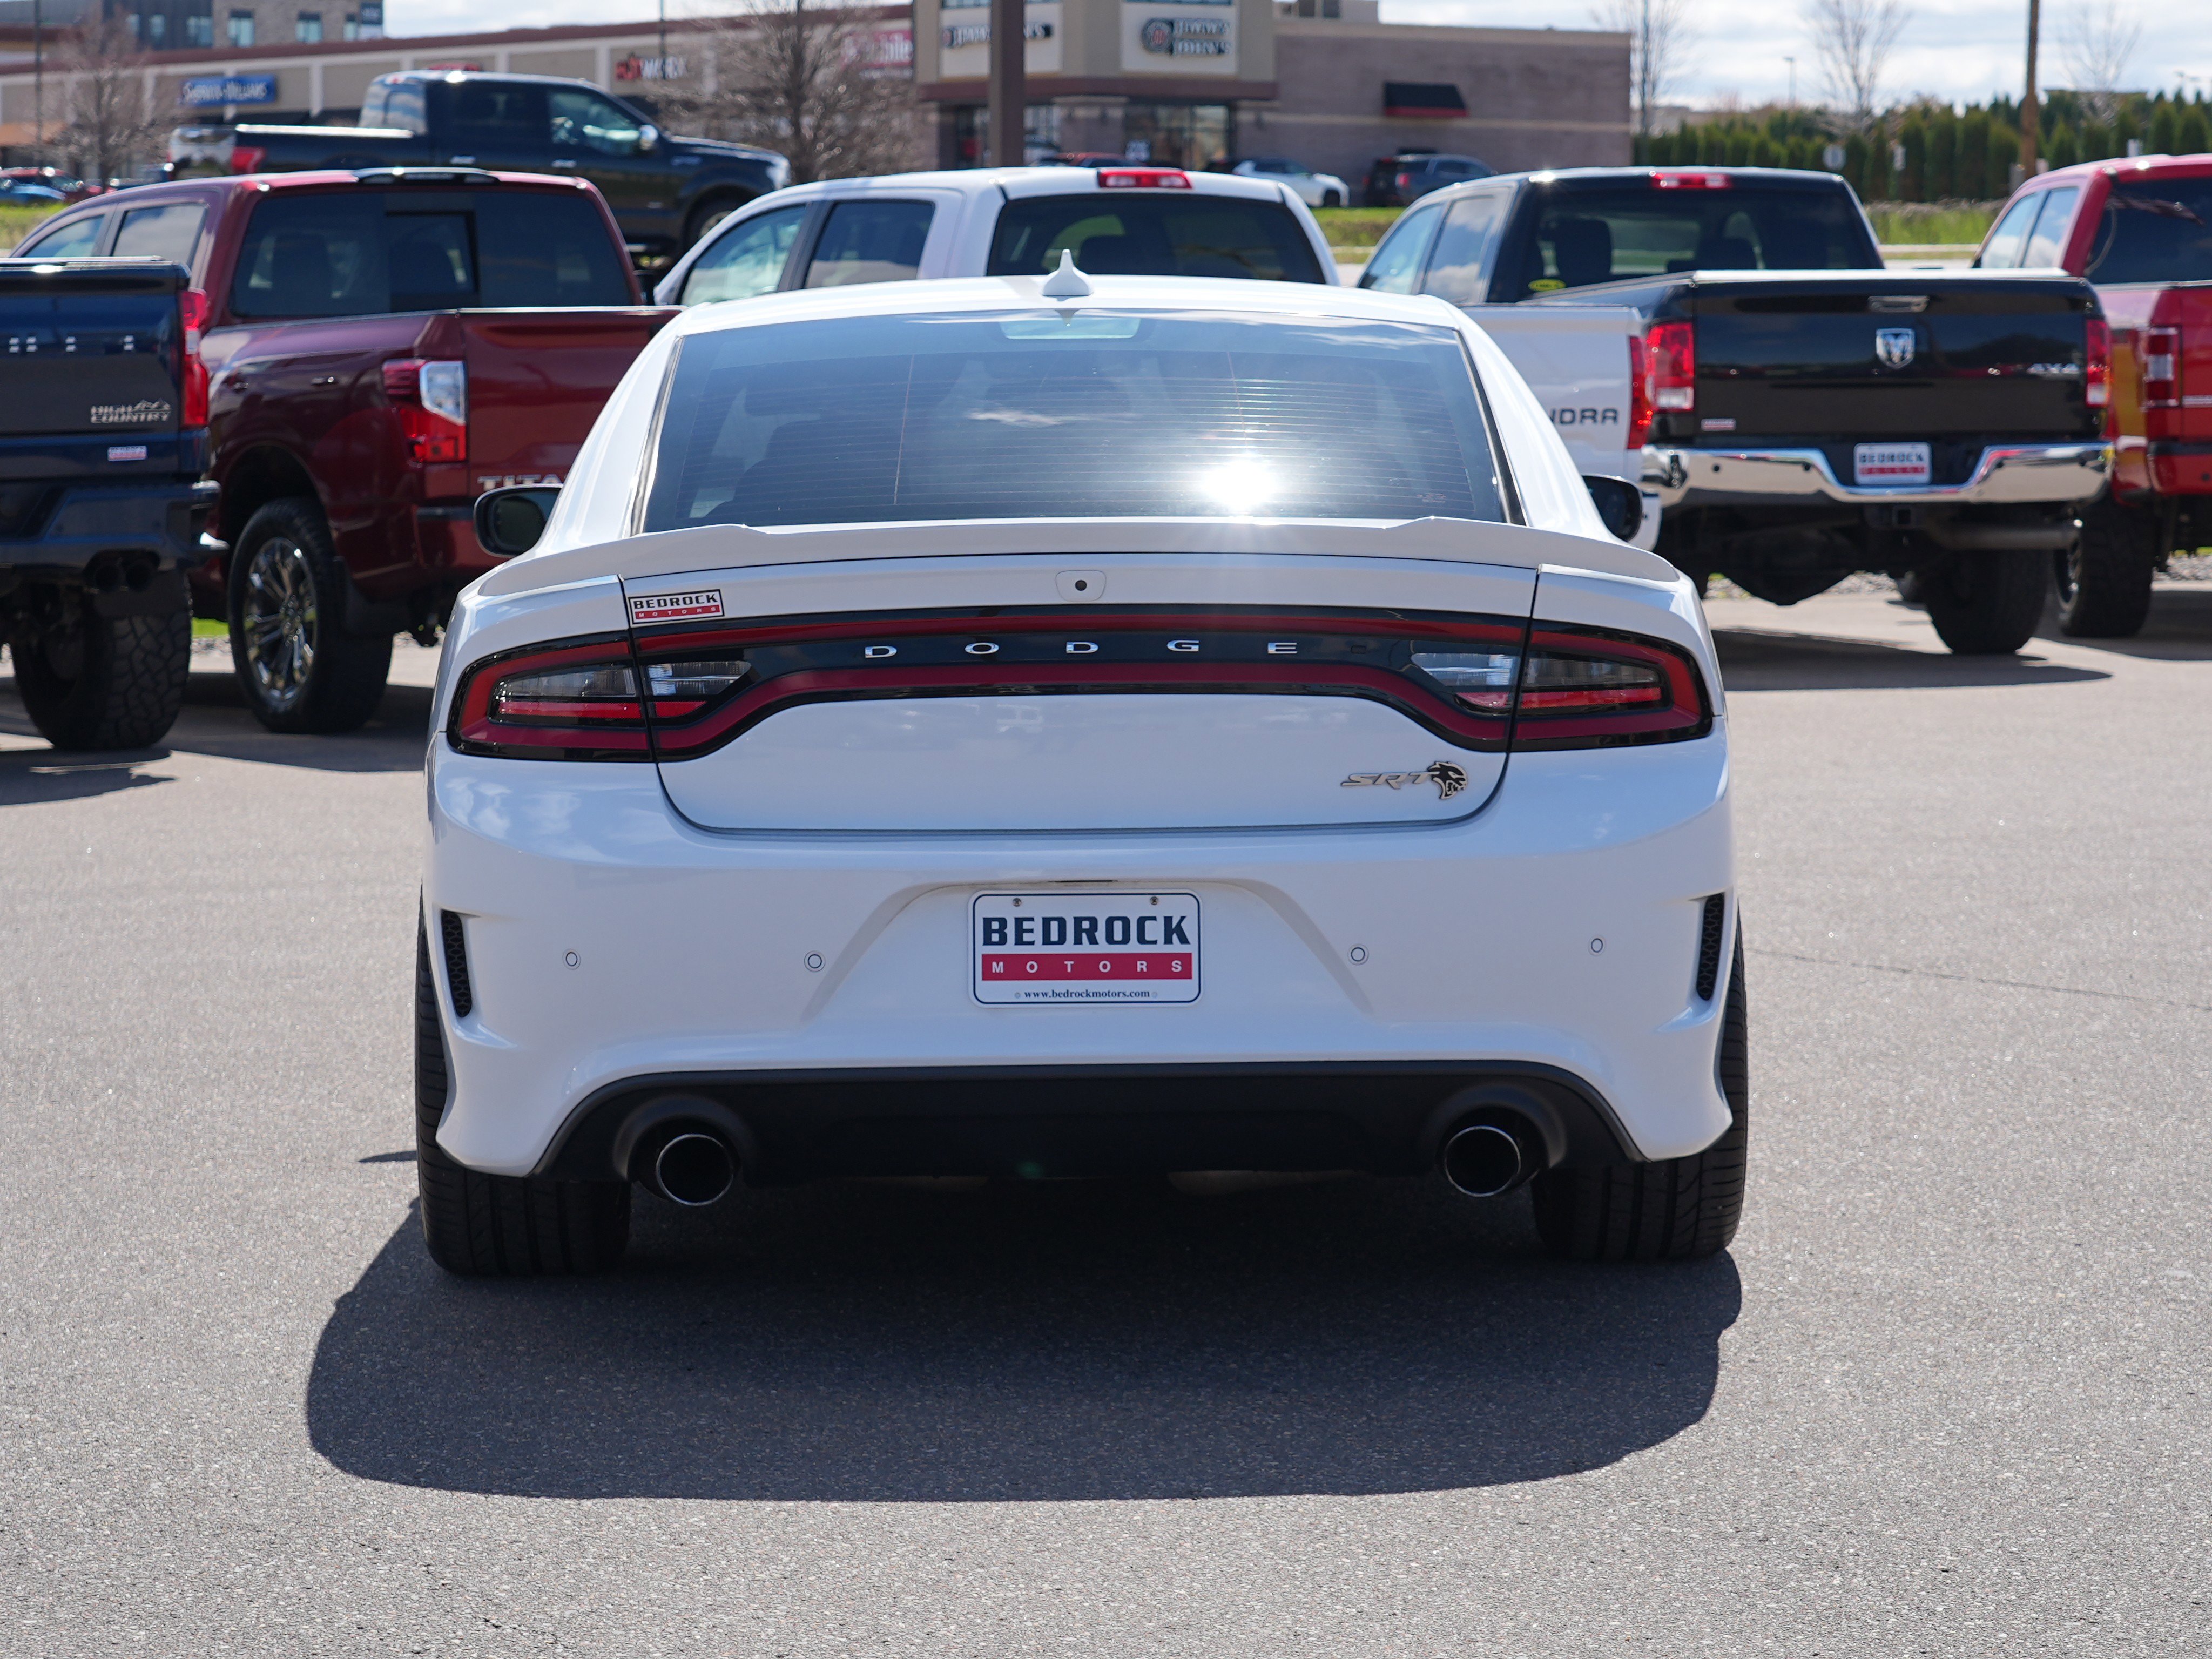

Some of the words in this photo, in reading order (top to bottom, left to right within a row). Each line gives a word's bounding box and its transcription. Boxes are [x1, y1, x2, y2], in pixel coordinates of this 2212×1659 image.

[90, 412, 171, 424] COUNTRY
[633, 594, 718, 610] BEDROCK
[638, 606, 717, 618] MOTORS
[864, 639, 1298, 659] DODGE
[1340, 772, 1440, 790] SRT
[982, 915, 1191, 946] BEDROCK
[992, 960, 1182, 973] MOTORS
[1024, 989, 1150, 999] www.bedrockmotors.com
